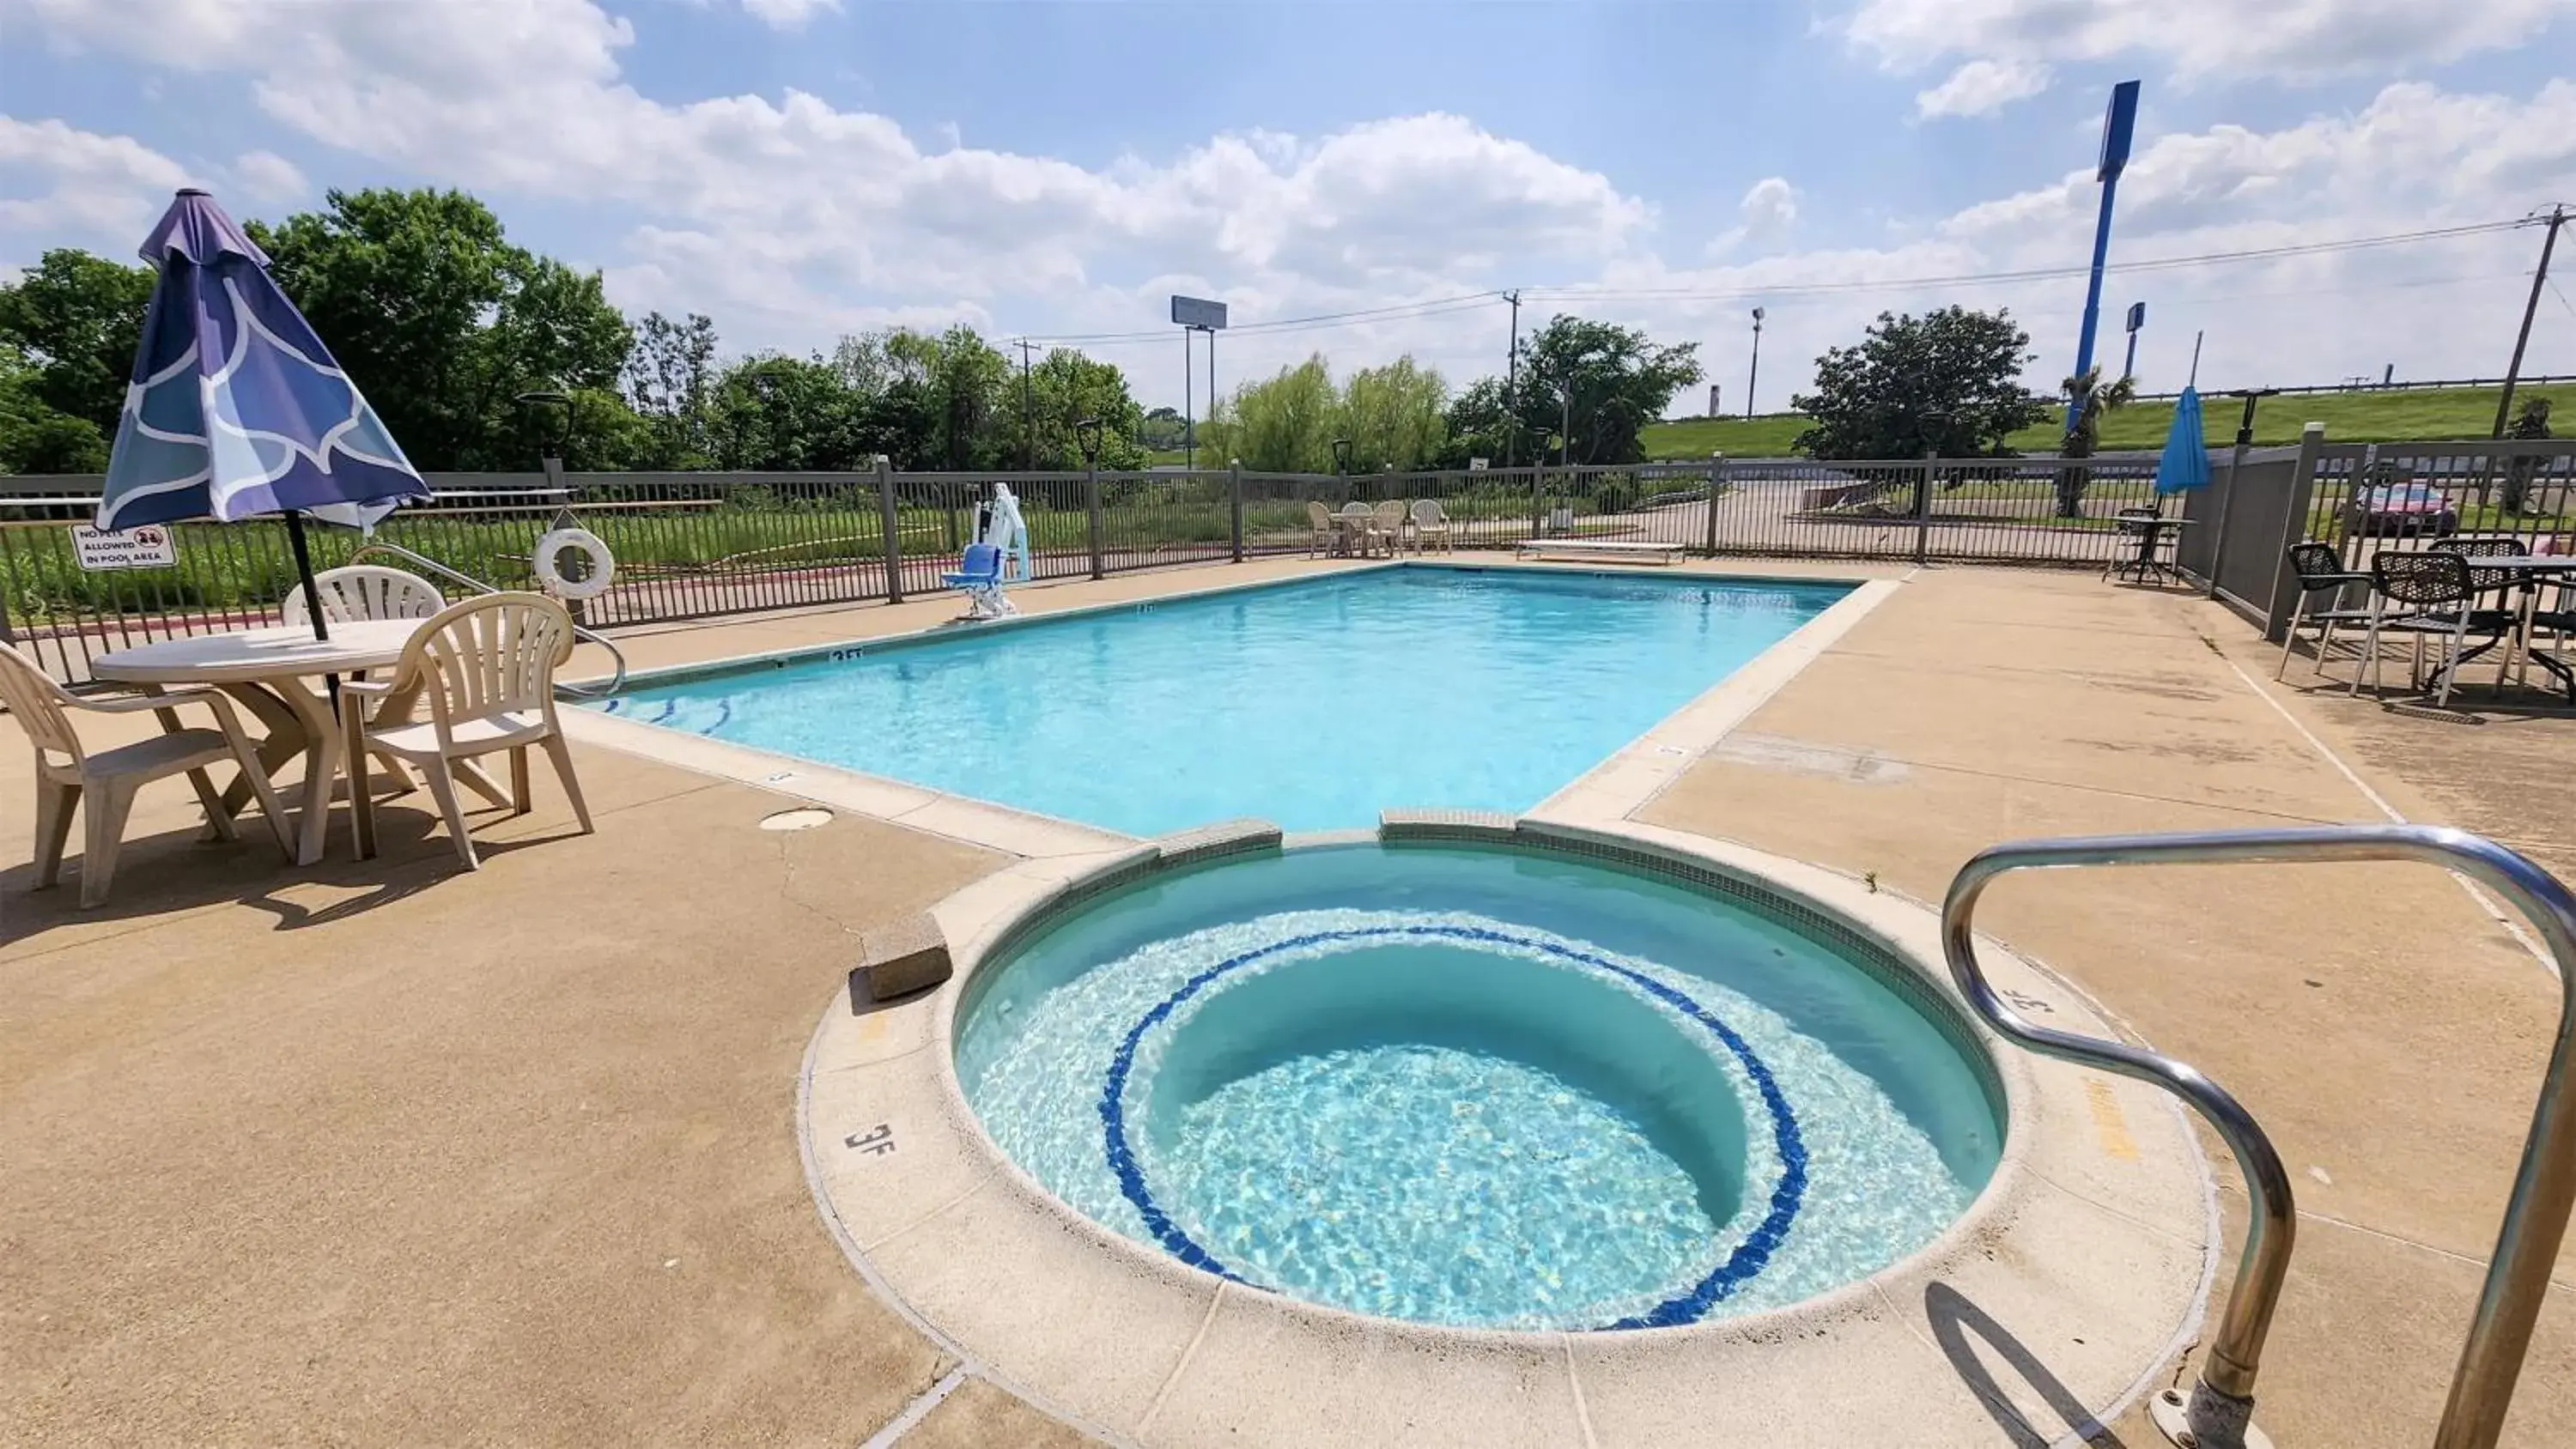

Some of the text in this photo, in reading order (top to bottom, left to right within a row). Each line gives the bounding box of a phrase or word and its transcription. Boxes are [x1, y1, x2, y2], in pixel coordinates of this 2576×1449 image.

[84, 542, 136, 550] ALLOWED
[87, 552, 161, 564] IN POOL AREA
